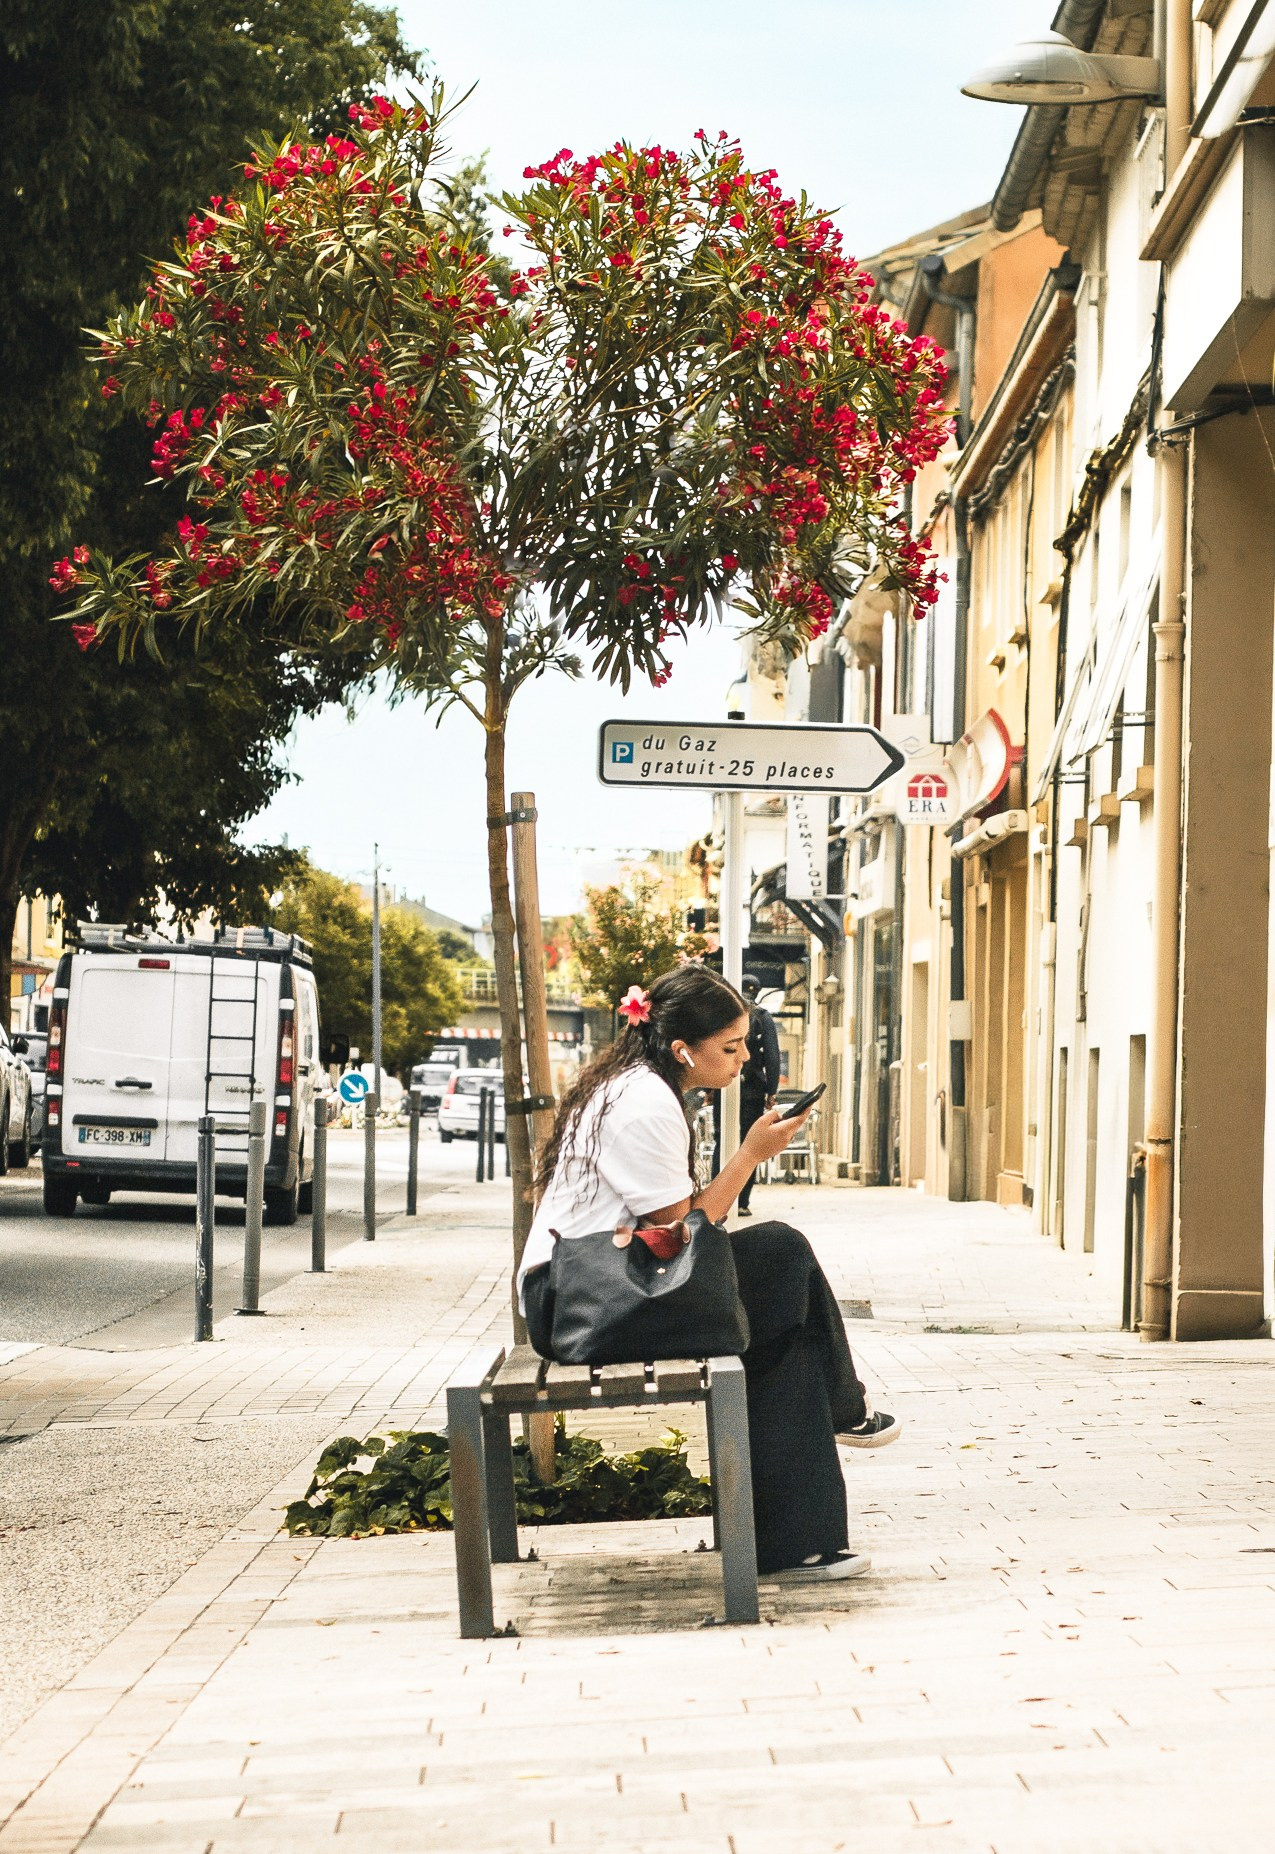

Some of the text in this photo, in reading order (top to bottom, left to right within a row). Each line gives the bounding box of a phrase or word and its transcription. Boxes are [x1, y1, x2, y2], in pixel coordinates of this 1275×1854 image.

[615, 744, 630, 762] P
[642, 734, 718, 753] du Gaz
[640, 758, 835, 781] gratuit-25 places
[908, 799, 946, 813] ERA
[792, 795, 823, 897] NFORMATIQUE
